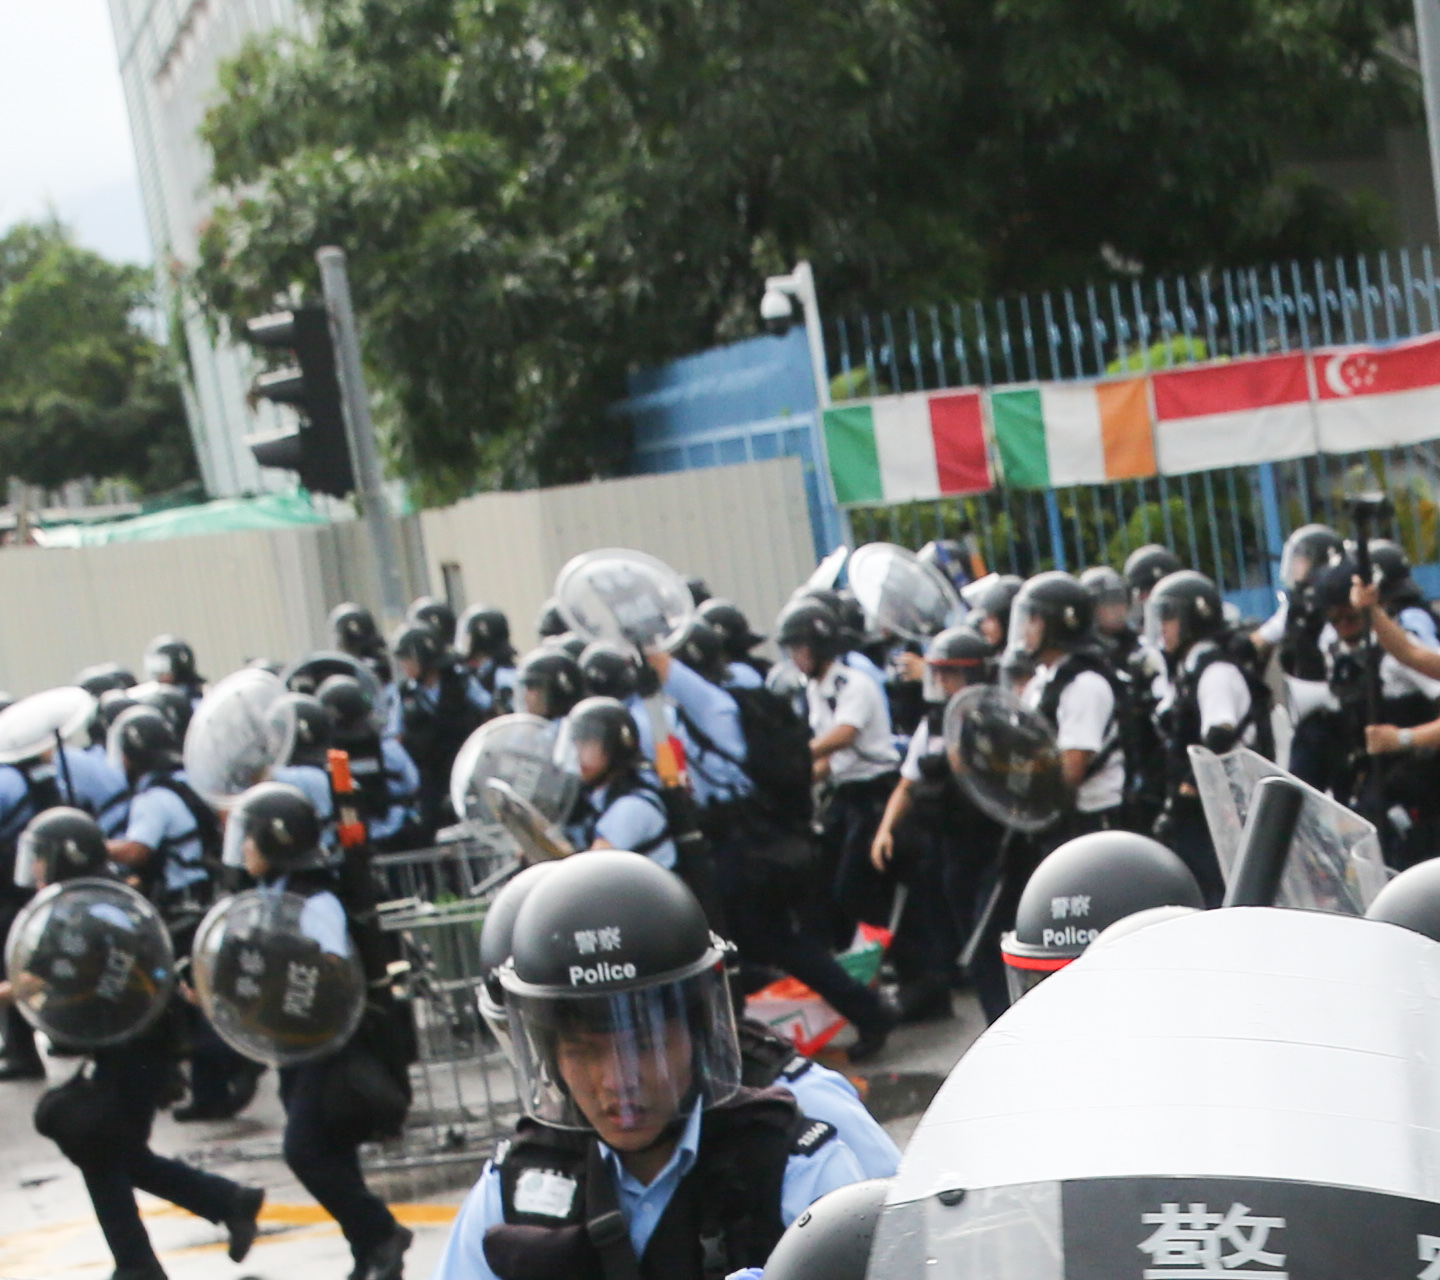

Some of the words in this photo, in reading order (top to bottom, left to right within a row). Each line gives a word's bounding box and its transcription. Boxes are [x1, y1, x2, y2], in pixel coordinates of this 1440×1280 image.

[1051, 895, 1091, 920] 警察
[574, 926, 621, 955] 警察
[1042, 926, 1100, 948] Police
[569, 961, 637, 987] Police
